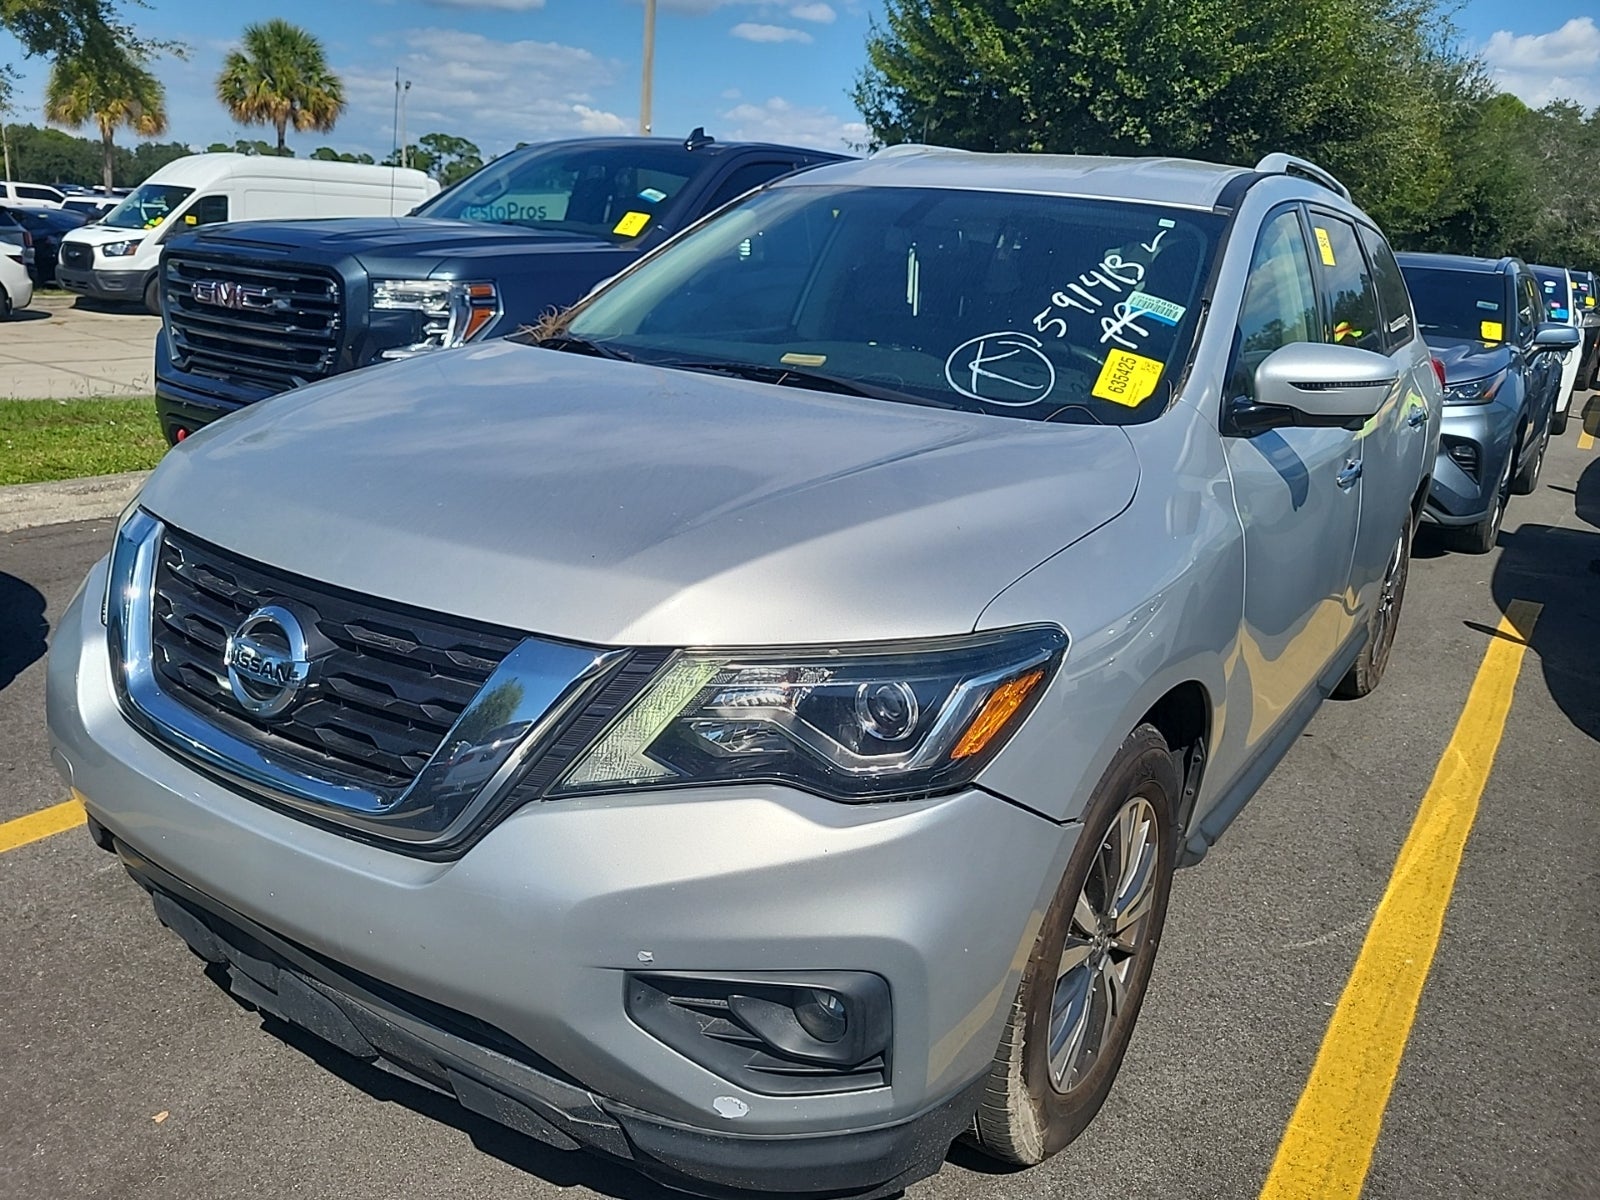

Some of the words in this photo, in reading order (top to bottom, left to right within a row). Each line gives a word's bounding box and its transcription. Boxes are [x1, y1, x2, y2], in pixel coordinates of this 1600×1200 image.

[191, 280, 276, 314] GMC
[968, 341, 1044, 393] K
[1107, 356, 1137, 394] 635425
